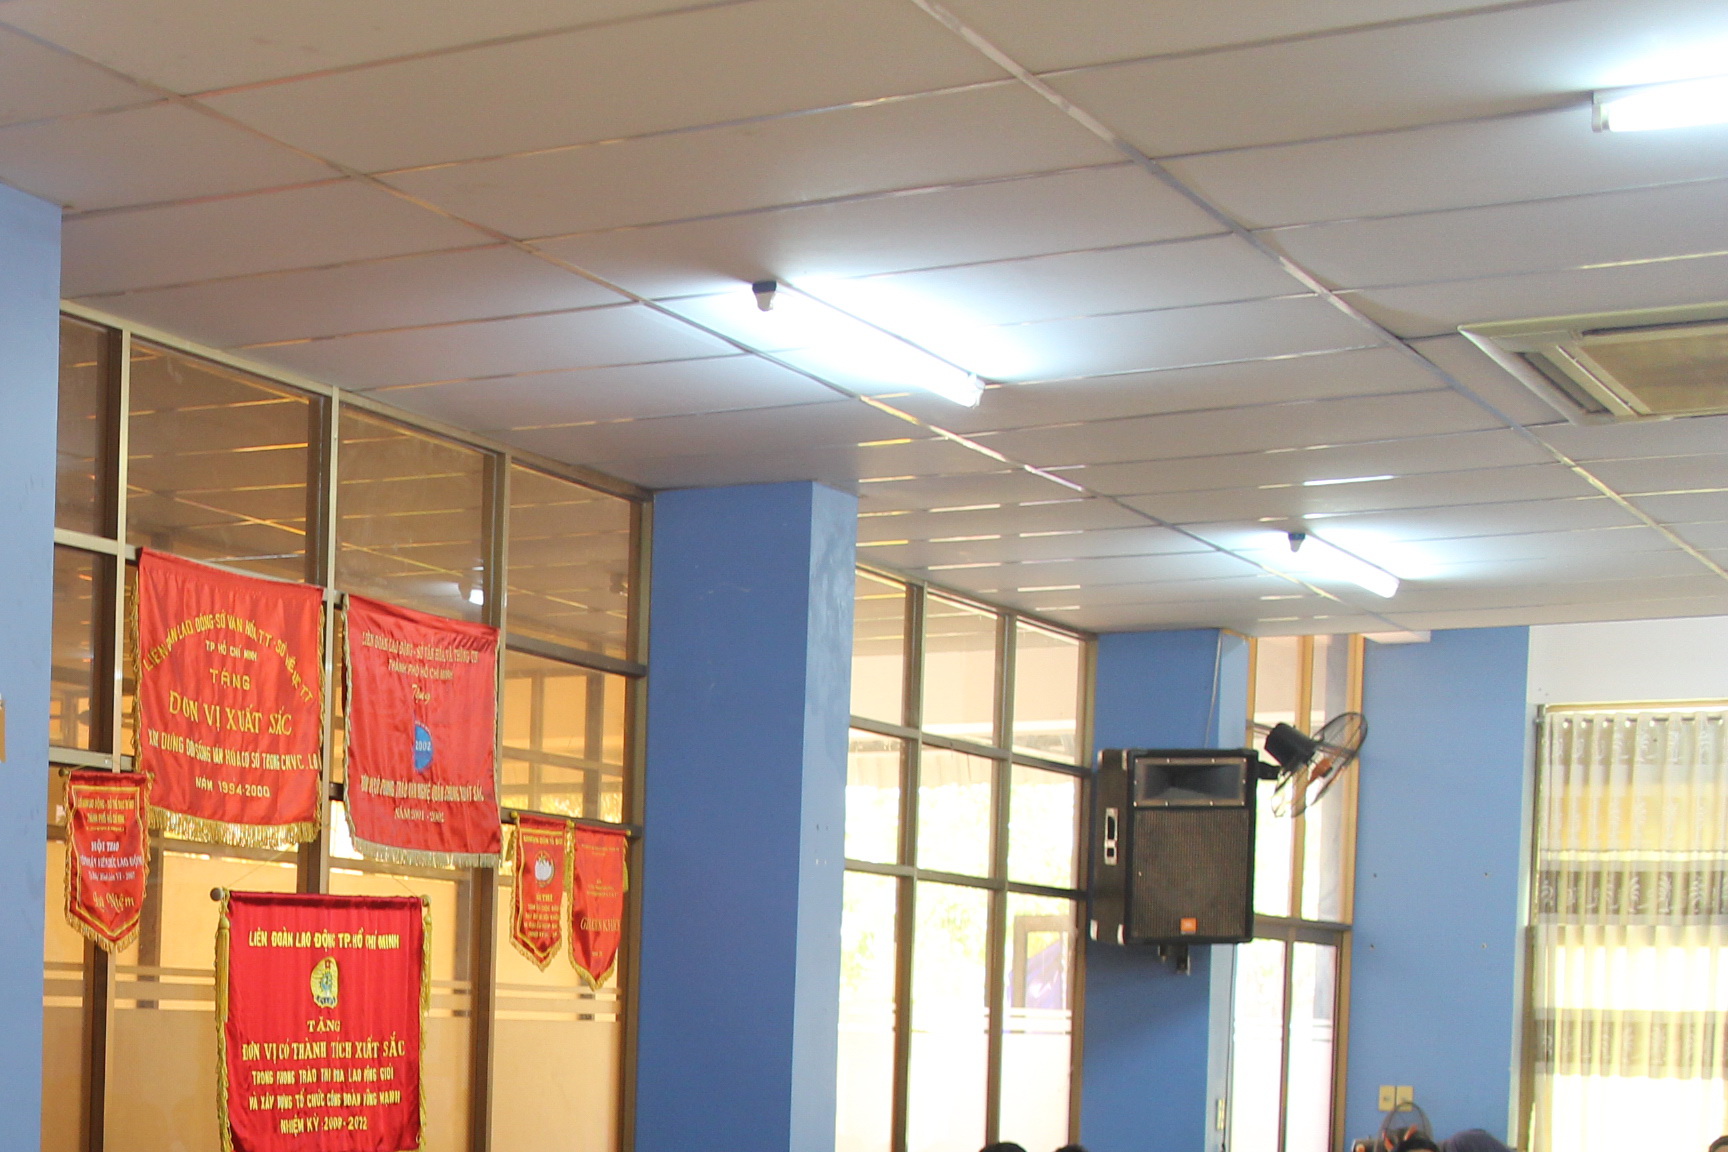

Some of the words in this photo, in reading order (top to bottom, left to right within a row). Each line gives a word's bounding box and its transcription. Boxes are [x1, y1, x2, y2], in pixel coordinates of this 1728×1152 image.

[177, 619, 194, 640] LAO
[209, 667, 251, 691] TẶNG
[203, 703, 221, 732] VỊ
[225, 704, 263, 734] XUẤT
[195, 776, 214, 792] NĂM
[249, 927, 268, 947] LIÊN
[271, 926, 294, 948] ĐOÀN
[296, 932, 312, 948] LAO
[377, 933, 400, 949] MINH
[307, 1016, 341, 1033] TẶNG
[242, 1041, 260, 1061] ĐƠN
[264, 1043, 277, 1064] VỊ
[279, 1038, 290, 1060] CÓ
[292, 1037, 327, 1060] THÀNH
[331, 1036, 352, 1059] TÍCH
[355, 1035, 379, 1058] XUẤT
[383, 1031, 405, 1057] SẮC
[252, 1070, 274, 1085] TRONG
[276, 1070, 295, 1085] PHONG
[299, 1066, 317, 1084] TRÀO
[348, 1067, 362, 1082] LAO
[249, 1091, 258, 1110] VÀ
[261, 1091, 274, 1110] XÂY
[343, 1089, 361, 1107] ĐOÀN
[280, 1113, 304, 1137] NHIỆM
